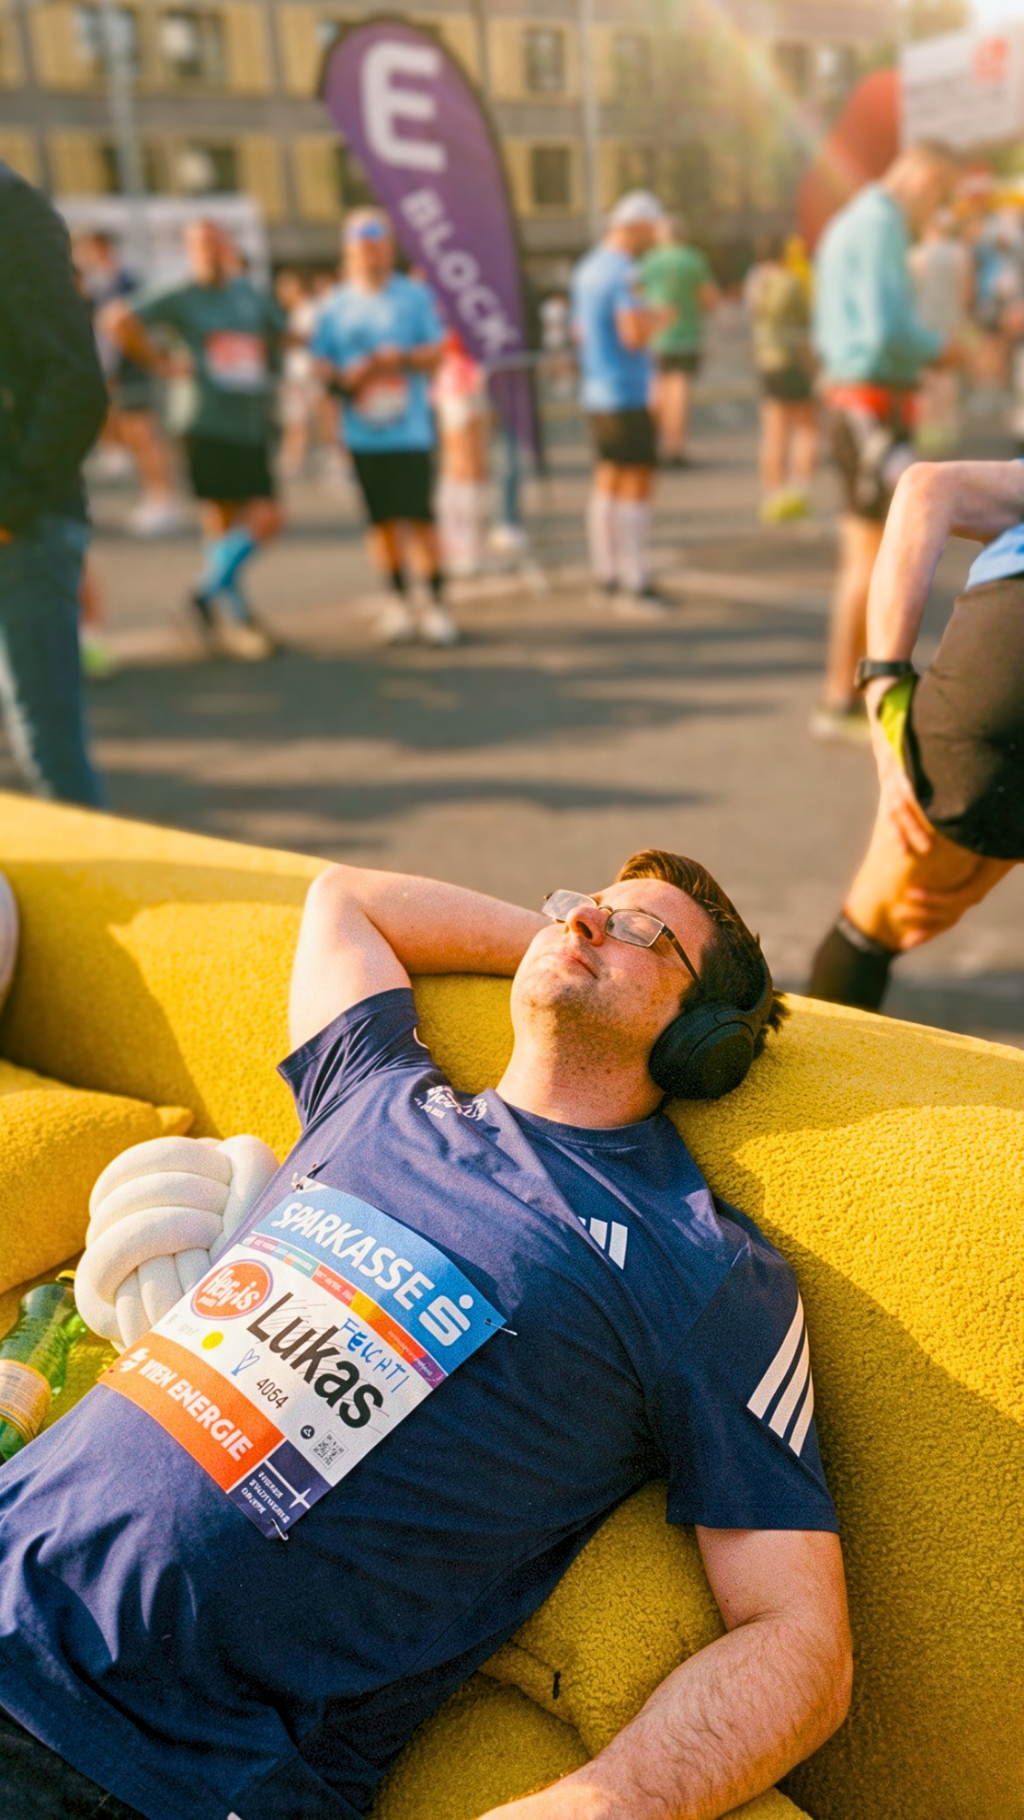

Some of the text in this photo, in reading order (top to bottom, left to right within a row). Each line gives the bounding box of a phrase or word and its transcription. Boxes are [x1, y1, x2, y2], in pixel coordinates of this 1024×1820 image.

[360, 40, 447, 173] E
[401, 189, 519, 355] BLOCK
[270, 1202, 435, 1310] SPARKASSE
[166, 1378, 254, 1462] ENERGIE
[246, 1292, 385, 1429] Lukas
